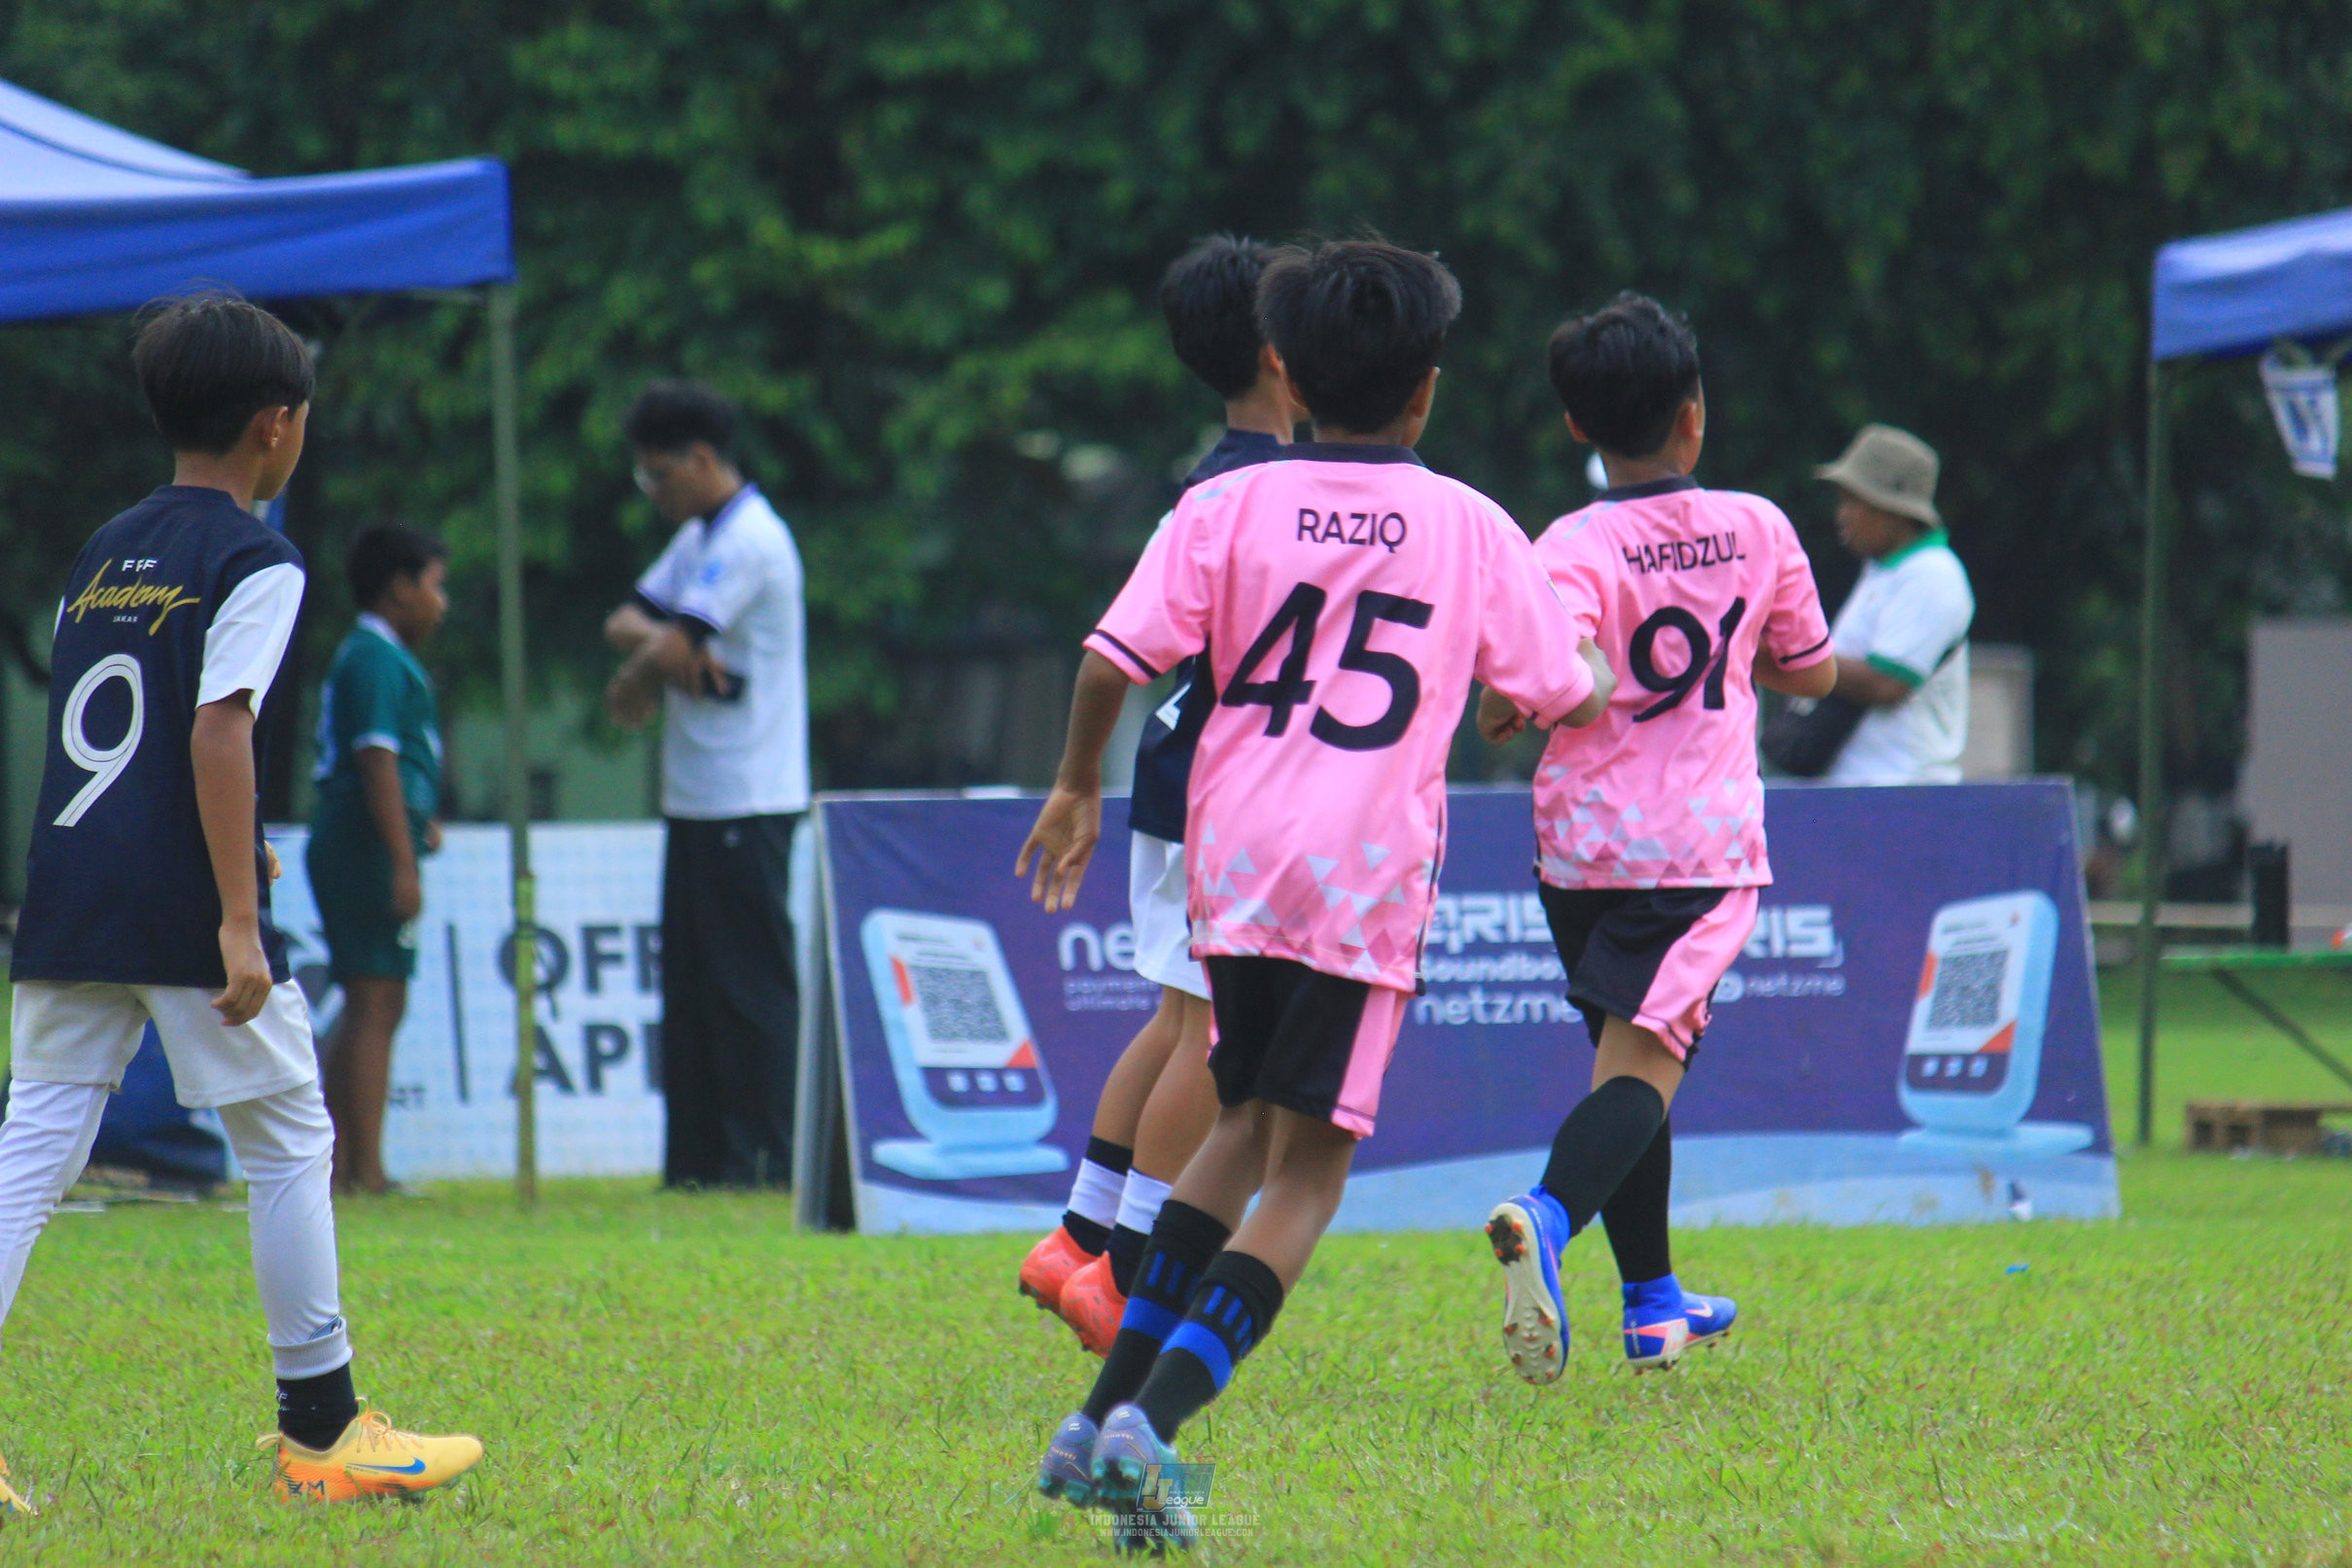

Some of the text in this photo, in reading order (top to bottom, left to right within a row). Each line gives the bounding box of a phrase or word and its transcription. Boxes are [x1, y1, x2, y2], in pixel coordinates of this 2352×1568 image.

[1297, 508, 1407, 552] RAZIQ
[1622, 531, 1746, 575] HAFIDZUL
[66, 558, 200, 636] Academy
[1220, 581, 1435, 752] 45
[1630, 596, 1746, 723] 91
[53, 653, 145, 828] 9
